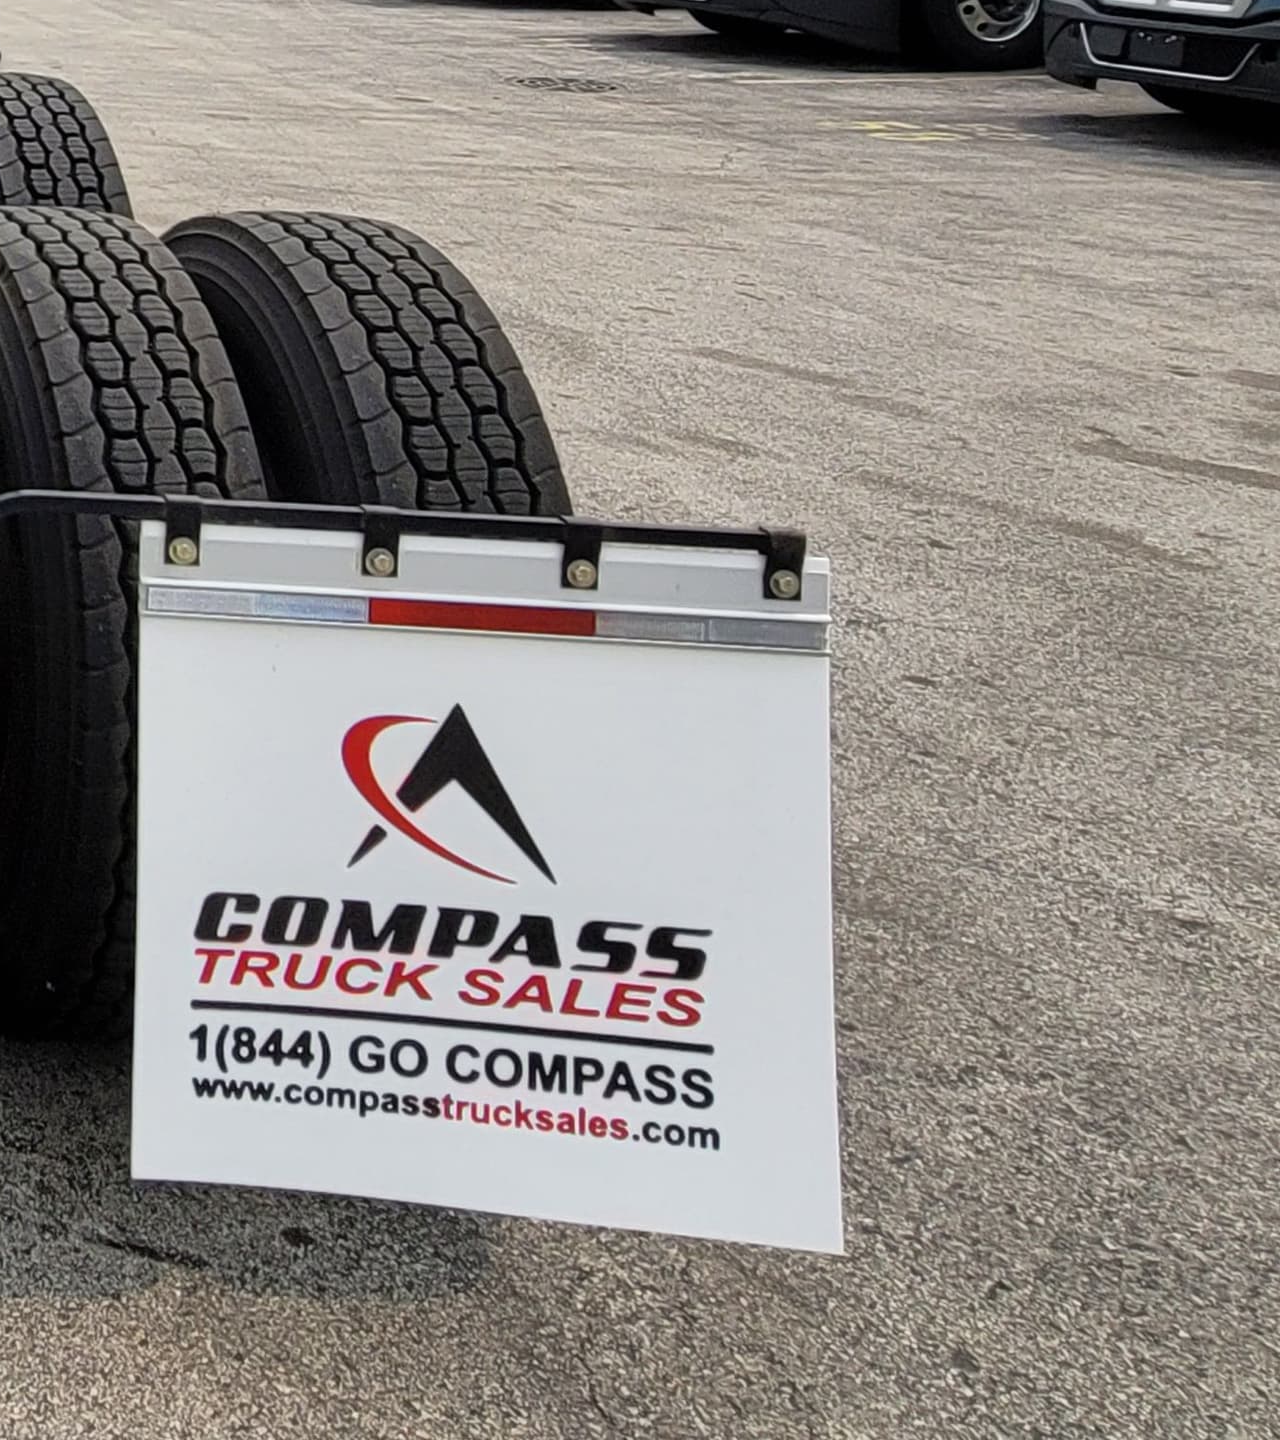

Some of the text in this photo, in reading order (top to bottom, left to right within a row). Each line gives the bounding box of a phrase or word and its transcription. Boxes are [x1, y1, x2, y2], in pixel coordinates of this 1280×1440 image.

[193, 891, 713, 982] COMPASS
[194, 947, 706, 1027] TRUCK SALES
[189, 1023, 715, 1110] 1(844) GO COMPASS
[191, 1076, 721, 1152] www.compasstrucksales.com
